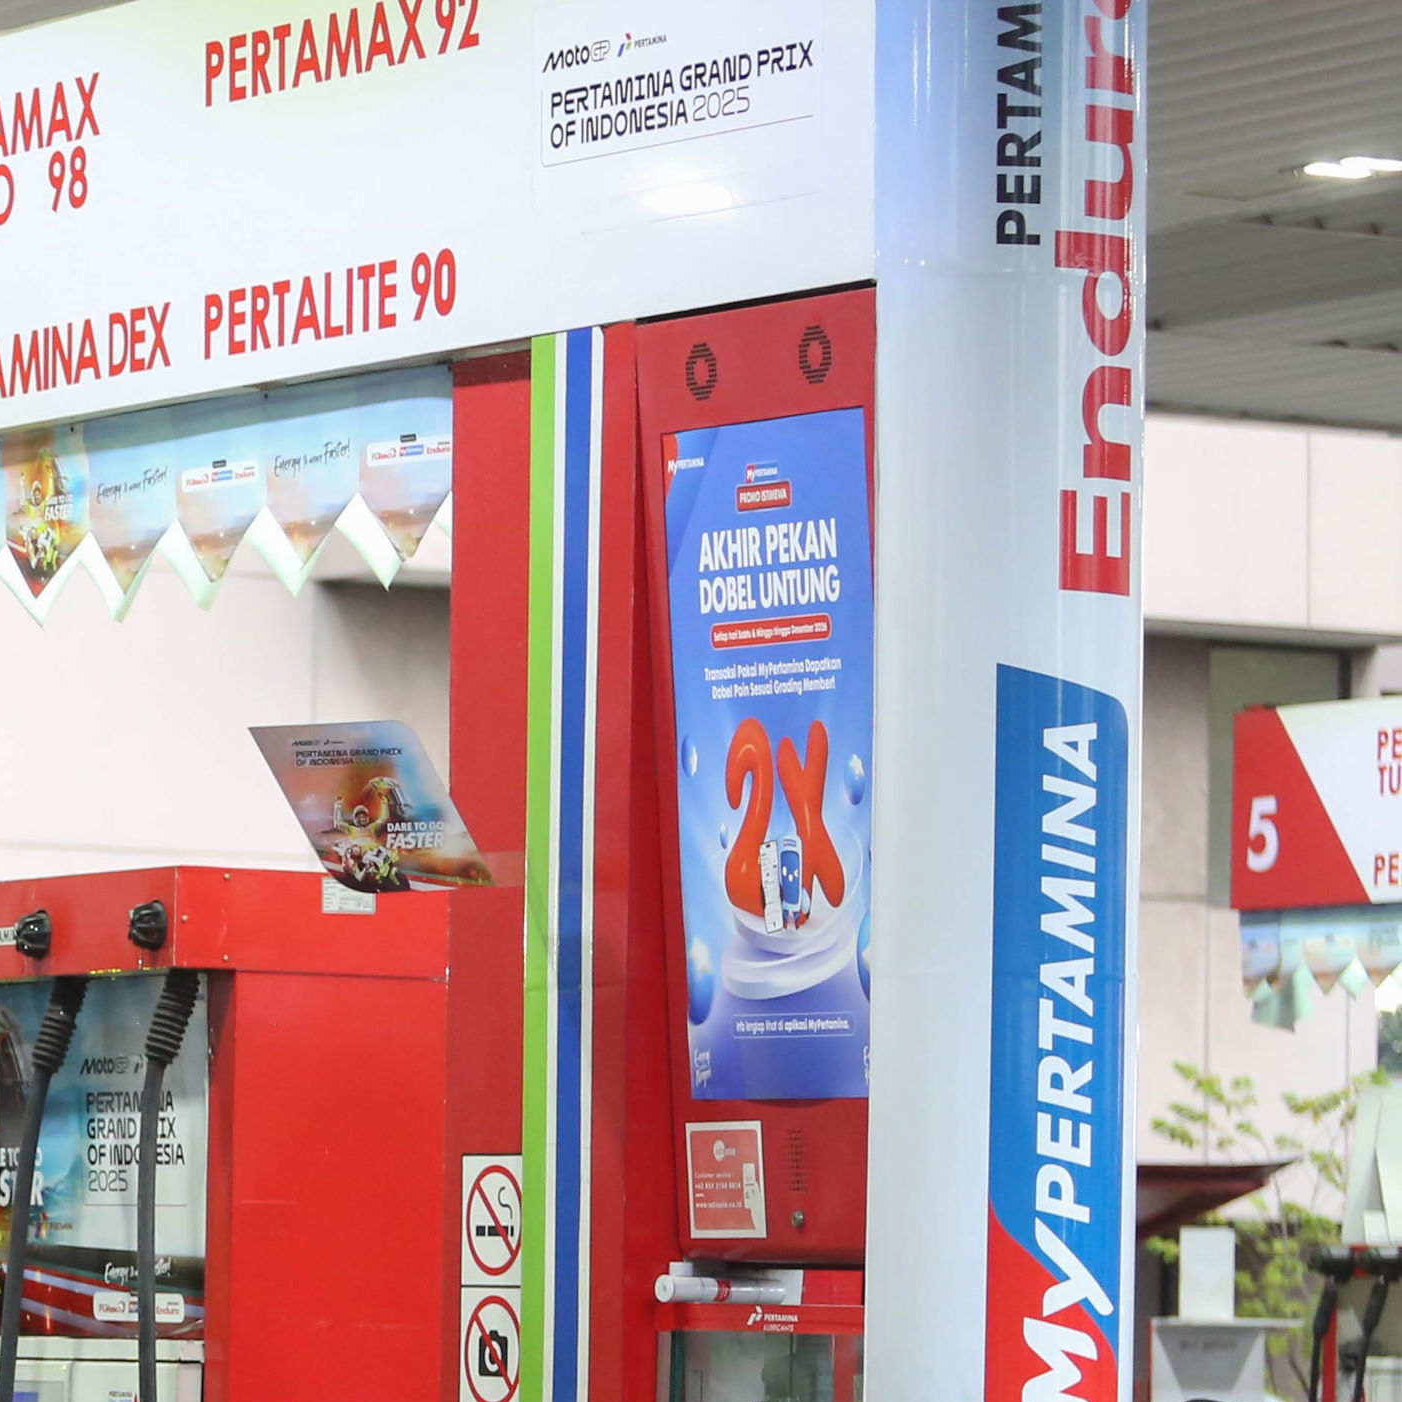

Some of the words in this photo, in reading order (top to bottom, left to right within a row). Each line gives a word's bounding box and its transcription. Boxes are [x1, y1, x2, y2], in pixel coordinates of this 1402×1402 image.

[204, 0, 426, 107] PERTAMAX
[435, 0, 481, 52] 92
[542, 39, 611, 73] MotoGP
[551, 69, 675, 118] PERTAMINA
[679, 53, 752, 91] GRAND
[756, 40, 814, 78] PRIX
[550, 119, 576, 149] OF
[581, 99, 688, 144] INDONESIA
[692, 85, 751, 122] 2025
[48, 148, 89, 212] 98
[203, 258, 398, 361] PERTALITE
[410, 248, 458, 322] 90
[1054, 0, 1134, 597] Endur
[107, 301, 172, 378] DEX
[699, 527, 762, 572] AKHIR
[765, 518, 837, 566] PEKAN
[699, 574, 756, 614] DOBEL
[759, 564, 841, 609] UNTUNG
[386, 831, 444, 849] FASTER
[387, 822, 413, 832] DARE
[414, 821, 427, 831] TO
[429, 821, 444, 830] GO
[725, 717, 845, 929] 2X
[1246, 795, 1279, 873] 5
[87, 1117, 137, 1139] GRAND
[87, 1144, 106, 1165] OF
[109, 1144, 185, 1165] INDOESIA
[88, 1170, 128, 1192] 2025
